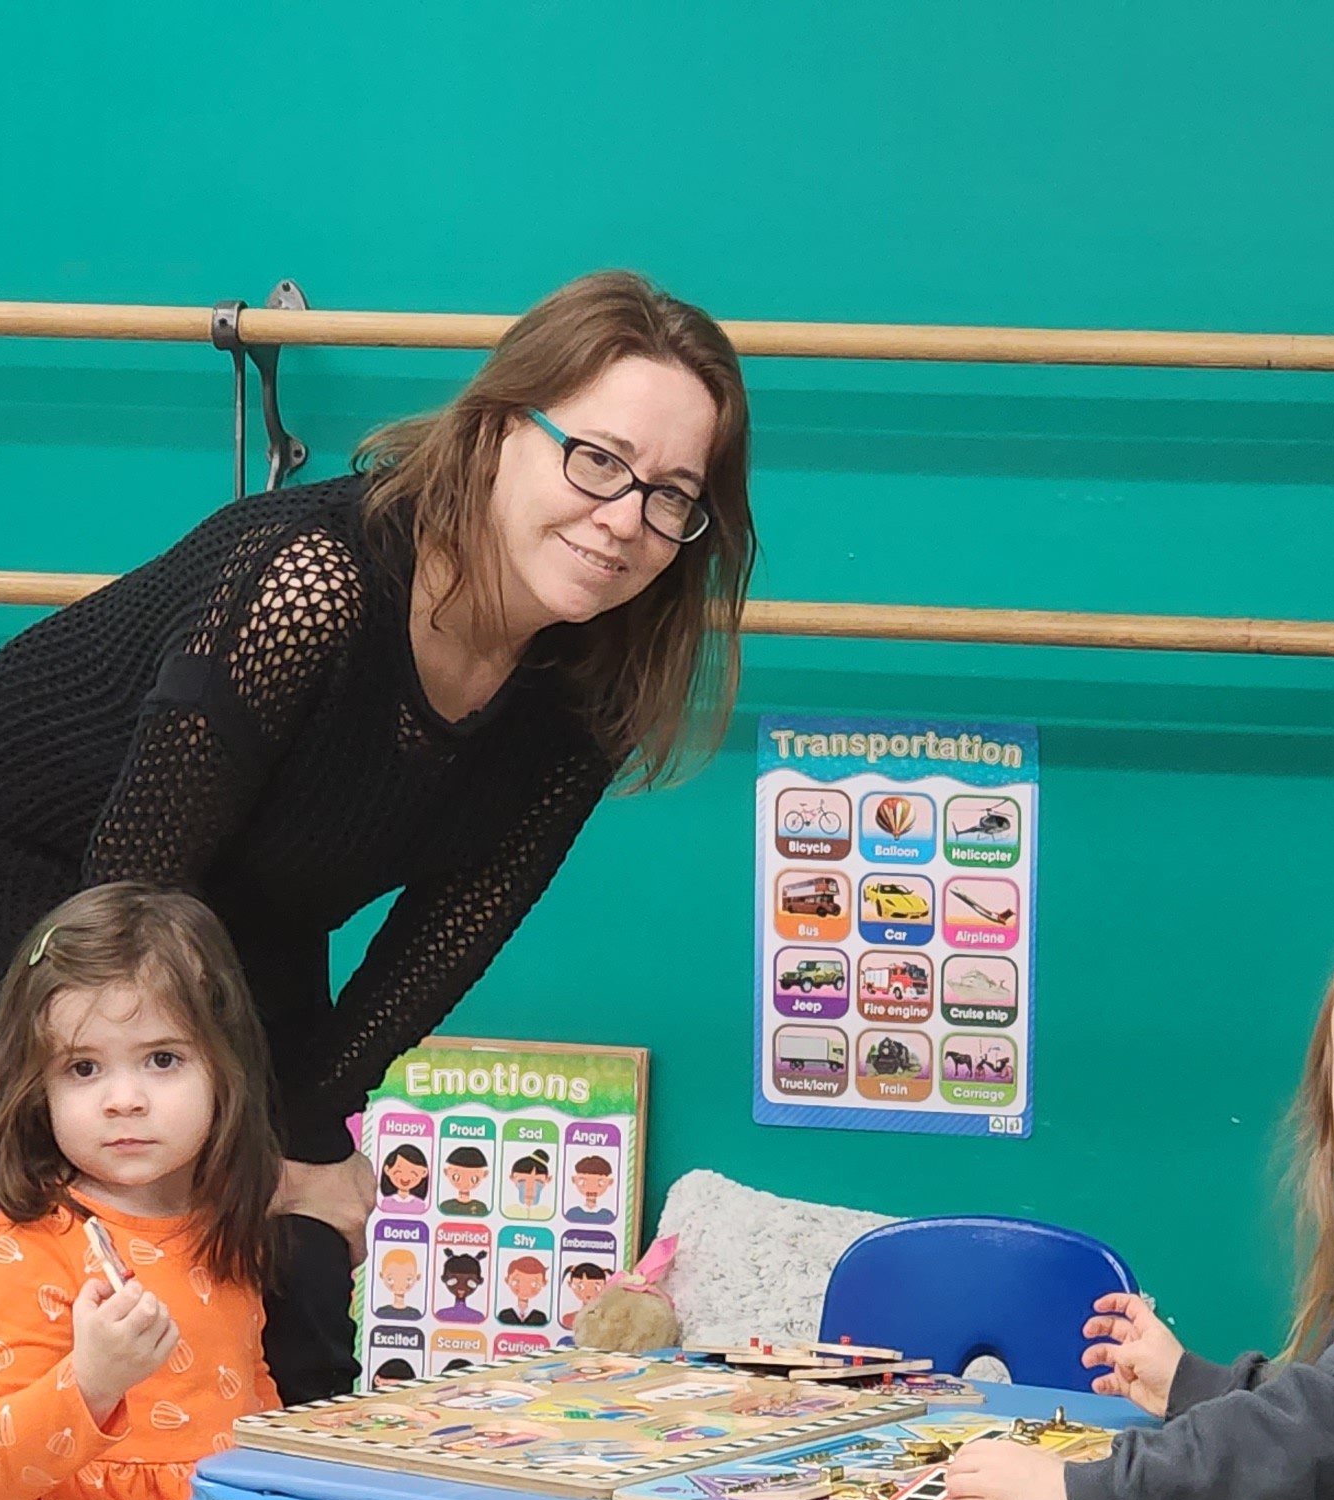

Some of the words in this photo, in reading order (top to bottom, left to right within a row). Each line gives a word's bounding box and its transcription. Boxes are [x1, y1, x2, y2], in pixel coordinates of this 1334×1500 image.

[771, 730, 1023, 768] Transportation
[789, 841, 831, 856] Bicycle
[875, 846, 919, 858] Balloon
[952, 848, 1012, 864] Helicopter
[798, 925, 819, 936] Bus
[885, 929, 907, 941] Car
[955, 930, 1005, 945] Airplane
[792, 1000, 822, 1013] Jeep
[864, 1003, 885, 1016] Fire
[887, 1006, 928, 1018] engine
[950, 1008, 984, 1020] Cruise
[987, 1009, 1009, 1022] ship
[405, 1062, 590, 1102] Emotions
[780, 1078, 839, 1092] Truck/lorry
[879, 1083, 907, 1095] Train
[953, 1087, 1005, 1101] Carriage
[386, 1120, 426, 1136] Happy
[449, 1123, 485, 1136] Proud
[519, 1127, 543, 1140] Sad
[573, 1130, 608, 1145] Angry
[383, 1226, 419, 1240] Bored
[437, 1229, 489, 1244] Surprised
[513, 1232, 536, 1247] Shy
[374, 1332, 418, 1346] Excited
[437, 1336, 481, 1350] Scared
